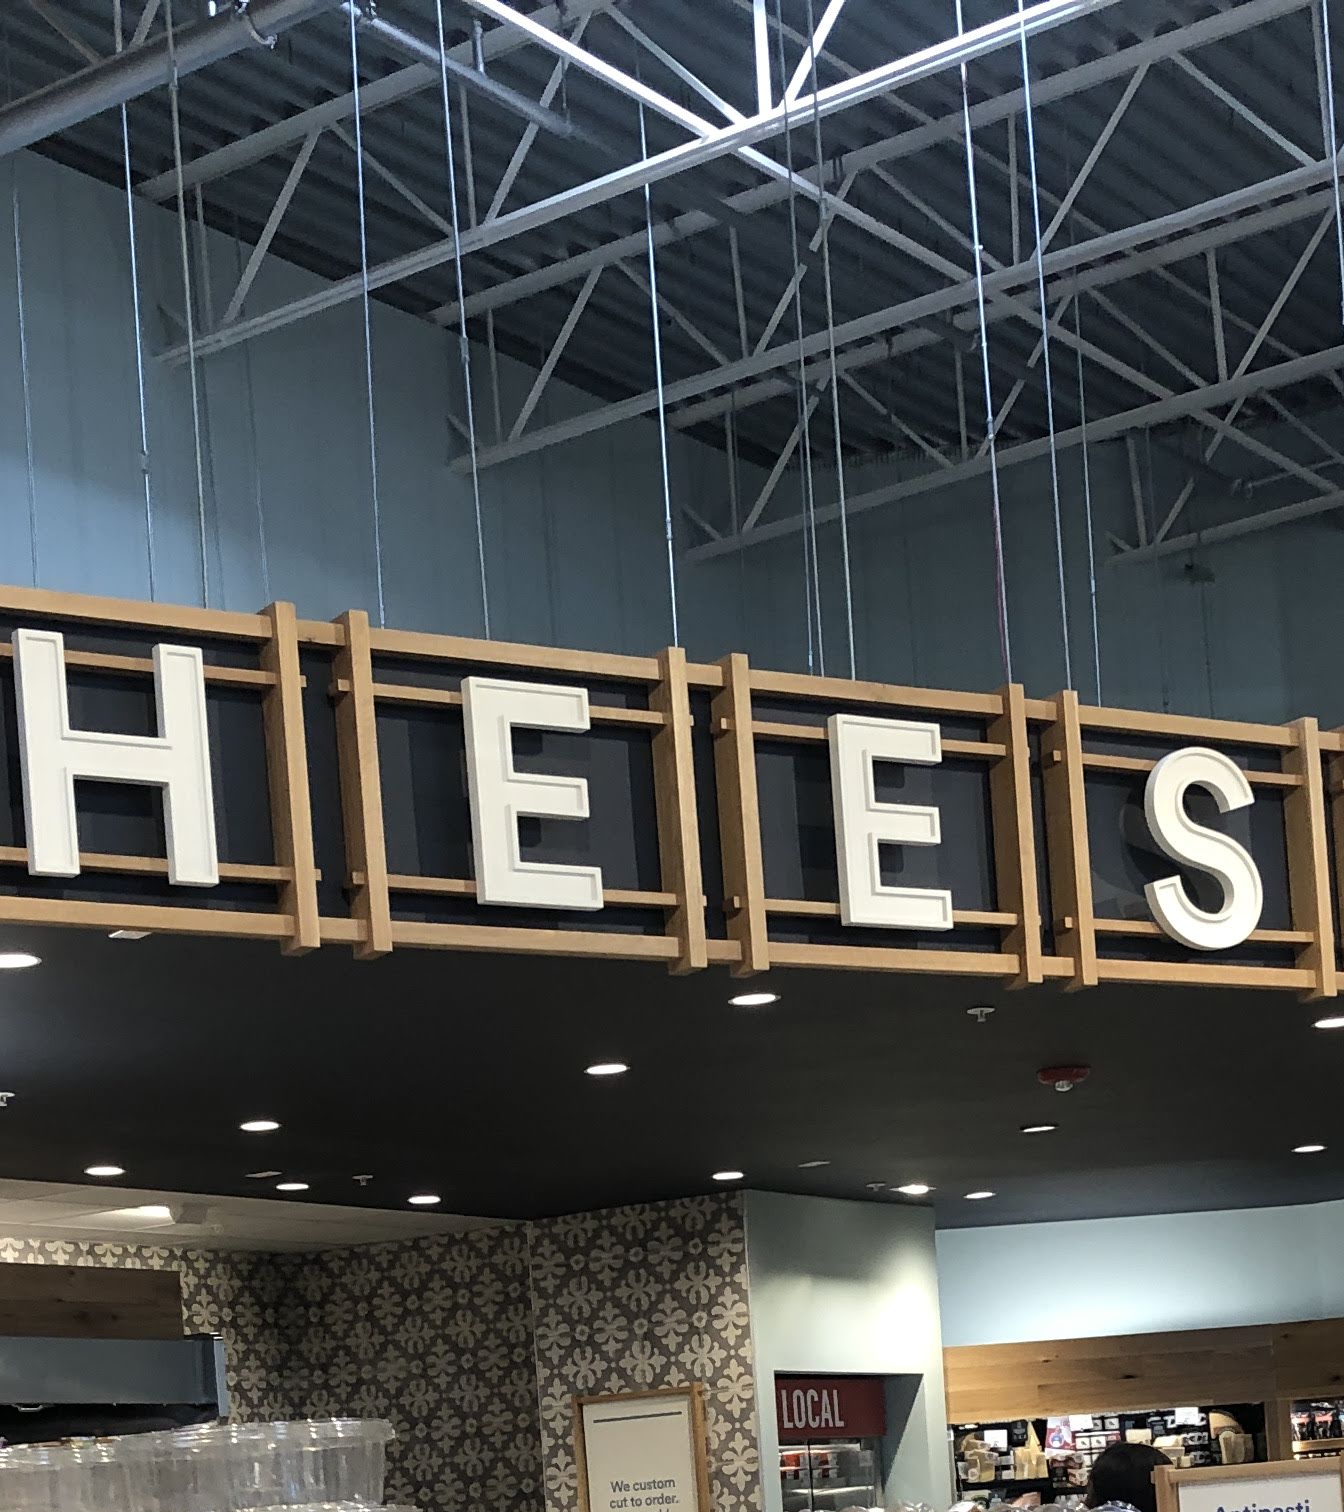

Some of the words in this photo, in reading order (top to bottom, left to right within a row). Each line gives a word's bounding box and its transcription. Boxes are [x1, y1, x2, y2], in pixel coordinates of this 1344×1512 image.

[781, 1389, 845, 1430] LOCAL
[610, 1480, 631, 1493] We
[633, 1478, 676, 1491] custom
[609, 1496, 629, 1509] cut
[630, 1496, 643, 1507] to
[645, 1493, 680, 1506] order.
